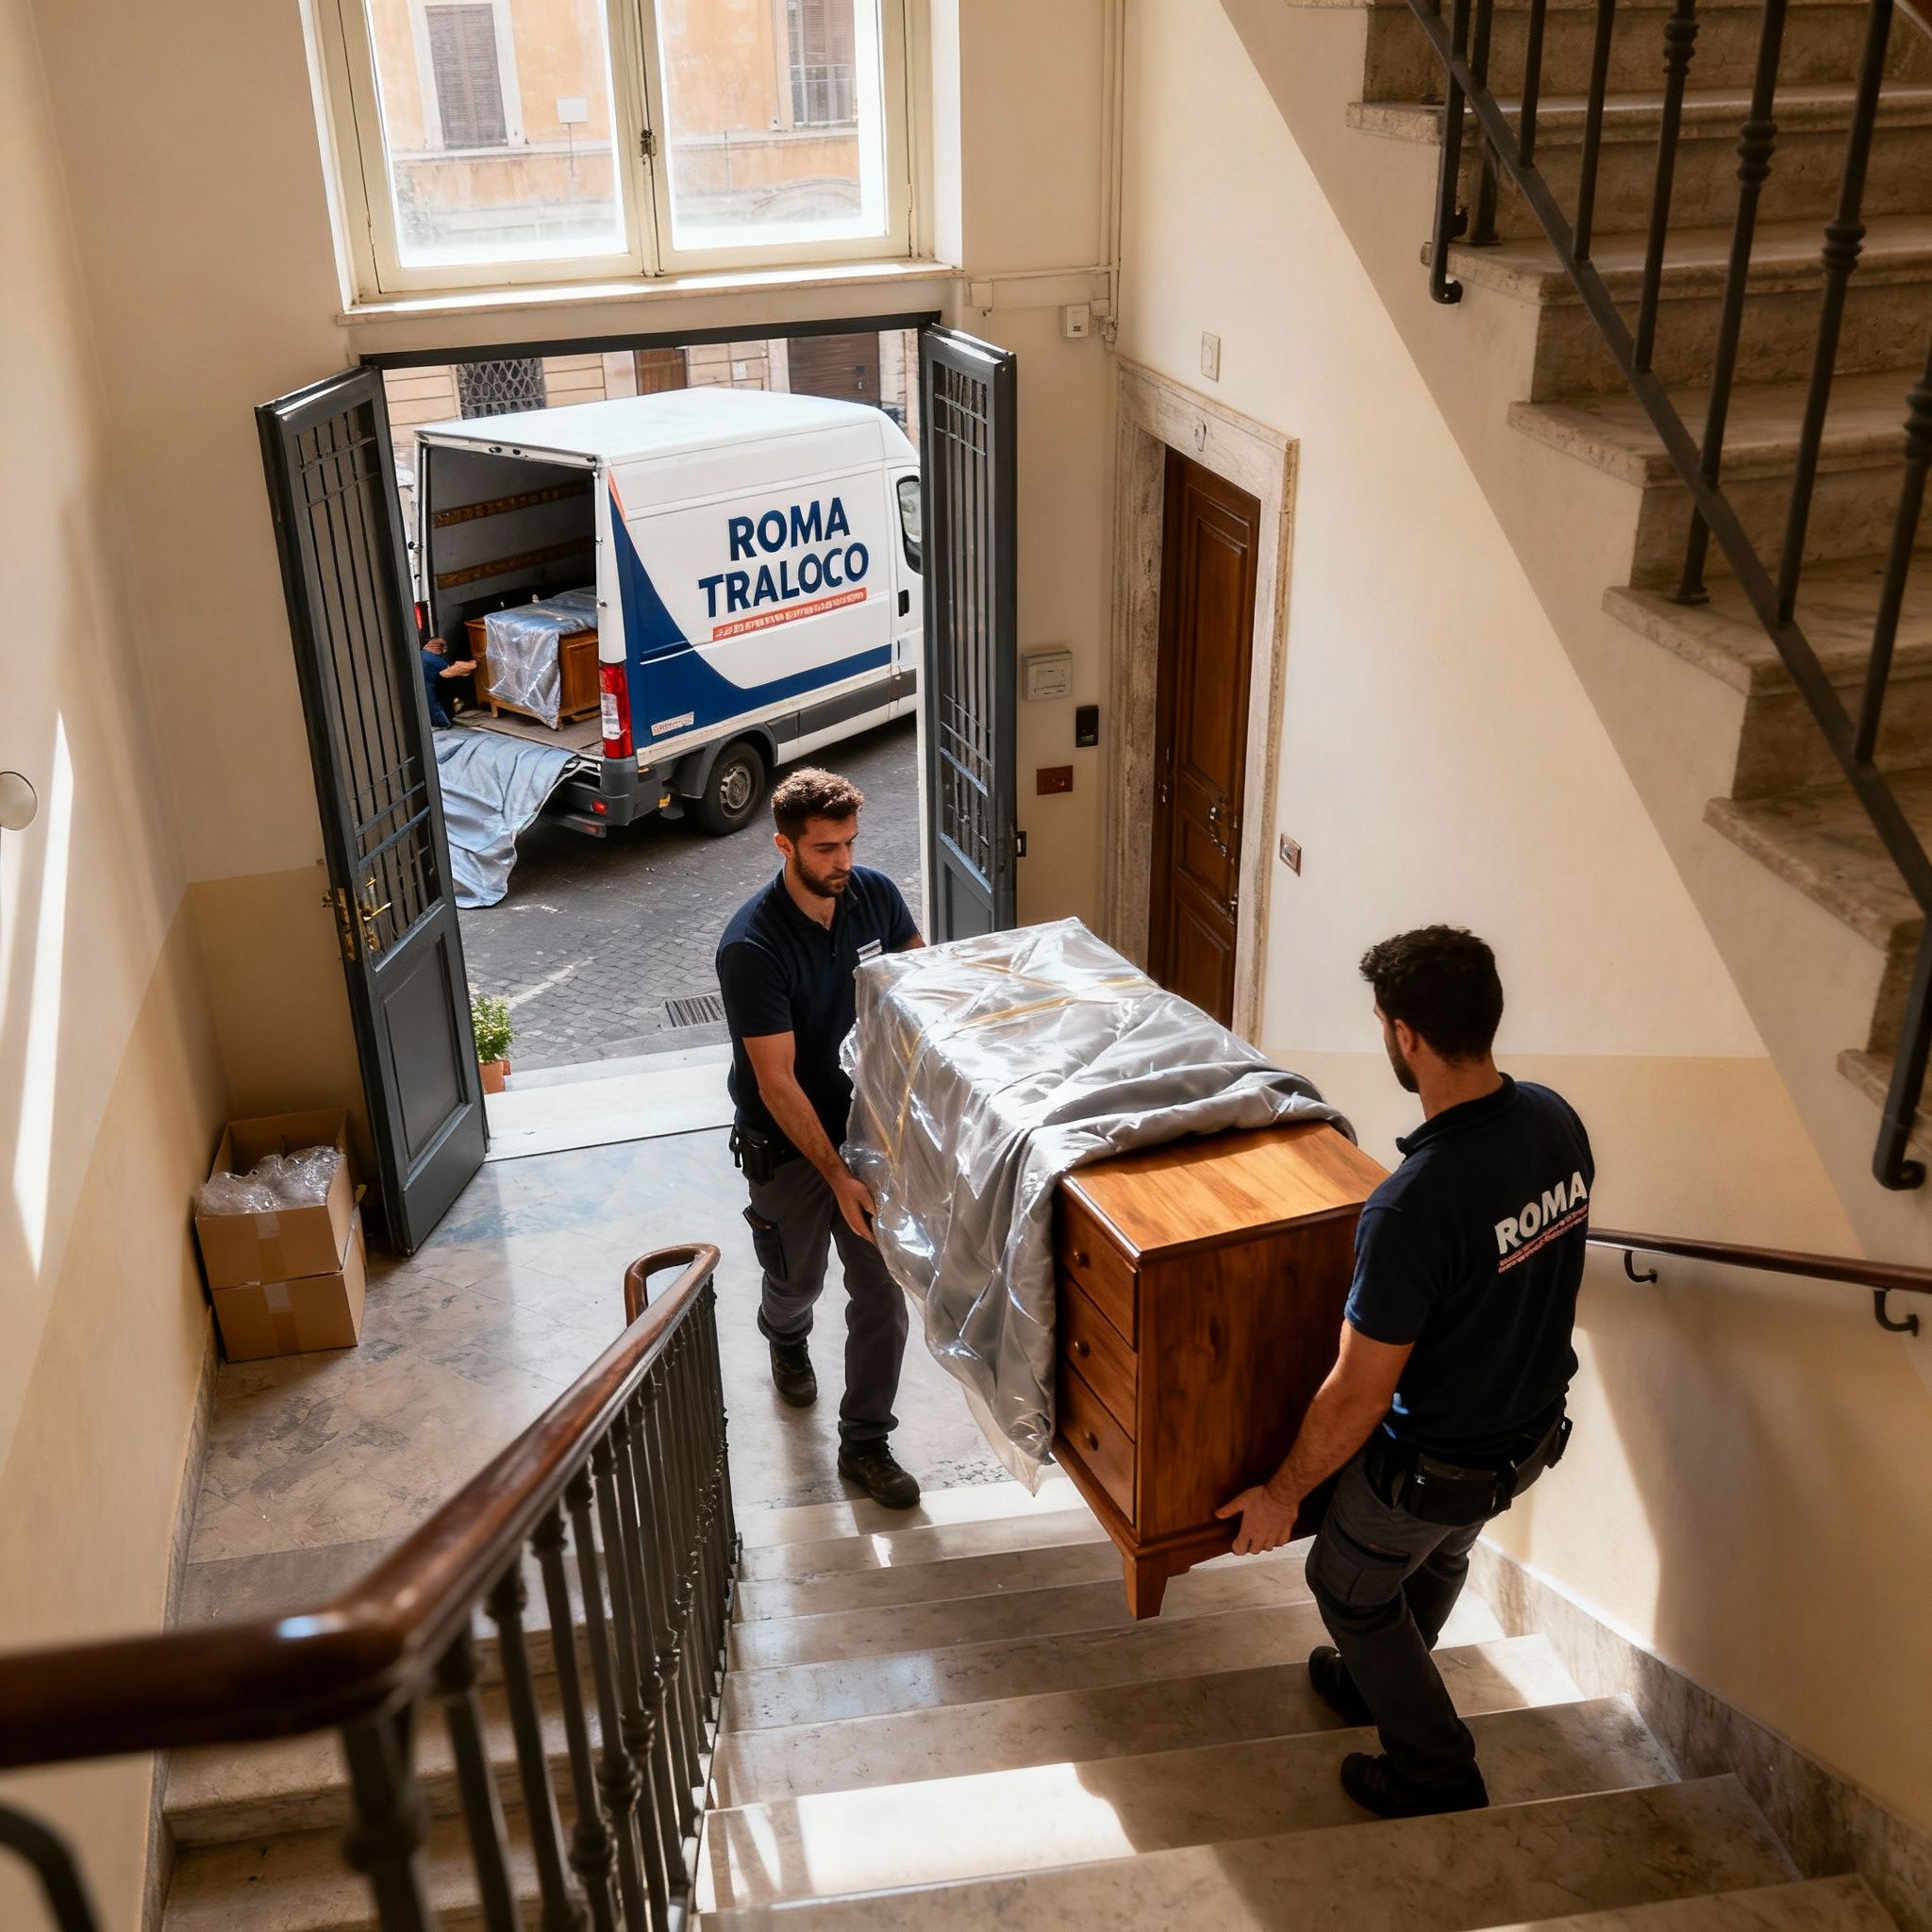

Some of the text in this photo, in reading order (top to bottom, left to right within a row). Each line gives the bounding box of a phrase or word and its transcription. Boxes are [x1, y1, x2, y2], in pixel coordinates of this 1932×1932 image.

[728, 497, 850, 561] ROMA
[698, 542, 869, 618] TRALOCO
[1494, 1171, 1588, 1255] ROMA
